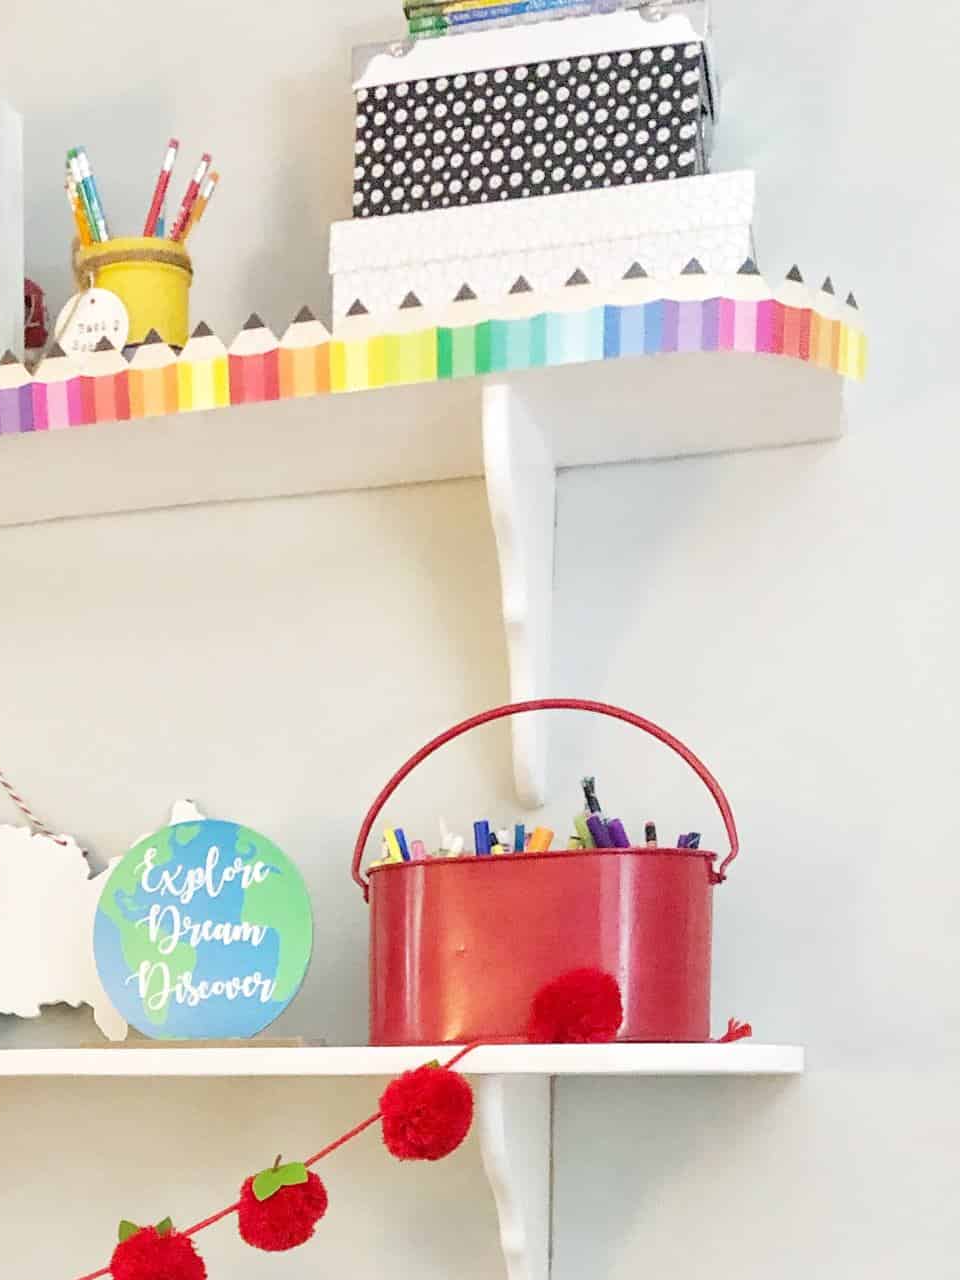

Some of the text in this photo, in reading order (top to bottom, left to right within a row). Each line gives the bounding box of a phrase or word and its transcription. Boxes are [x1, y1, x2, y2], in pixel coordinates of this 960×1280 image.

[134, 845, 271, 904] Explore
[136, 903, 267, 955] Dream
[124, 960, 278, 1010] Discover
